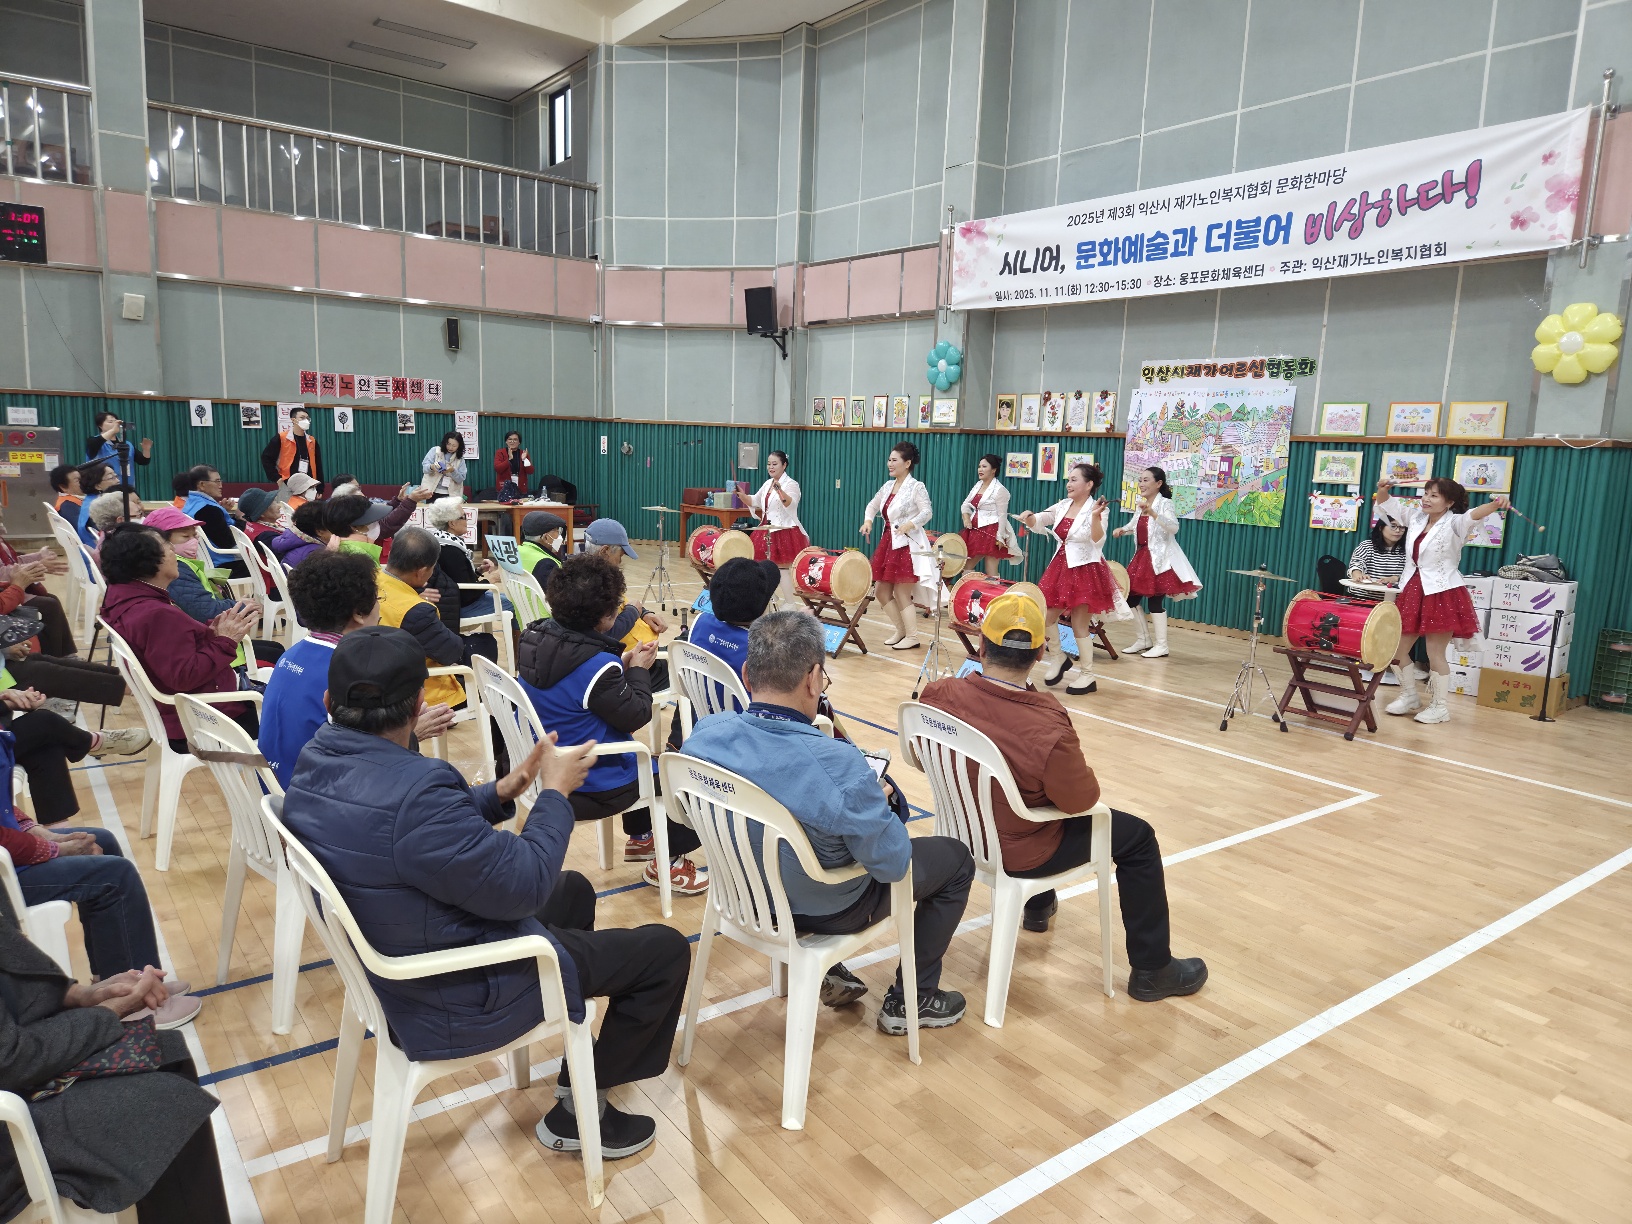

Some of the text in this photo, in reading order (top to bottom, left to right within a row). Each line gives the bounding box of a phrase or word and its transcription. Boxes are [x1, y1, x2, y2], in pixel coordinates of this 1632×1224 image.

[1066, 167, 1347, 227] 2025년 제3회 익산시 재가노인복지협회 문화한마당
[999, 158, 1482, 276] 시니어, 문화예술과 더불어 비상하다!
[1280, 241, 1447, 274] 주관: 익산재가노인복지협회
[995, 290, 1012, 302] 일시:
[1014, 289, 1037, 300] 2025.
[1039, 287, 1052, 298] 11.
[1085, 278, 1142, 294] 12:30~15:30
[1153, 264, 1265, 288] 장소: 웅포문화체육센터
[490, 538, 520, 565] 신광
